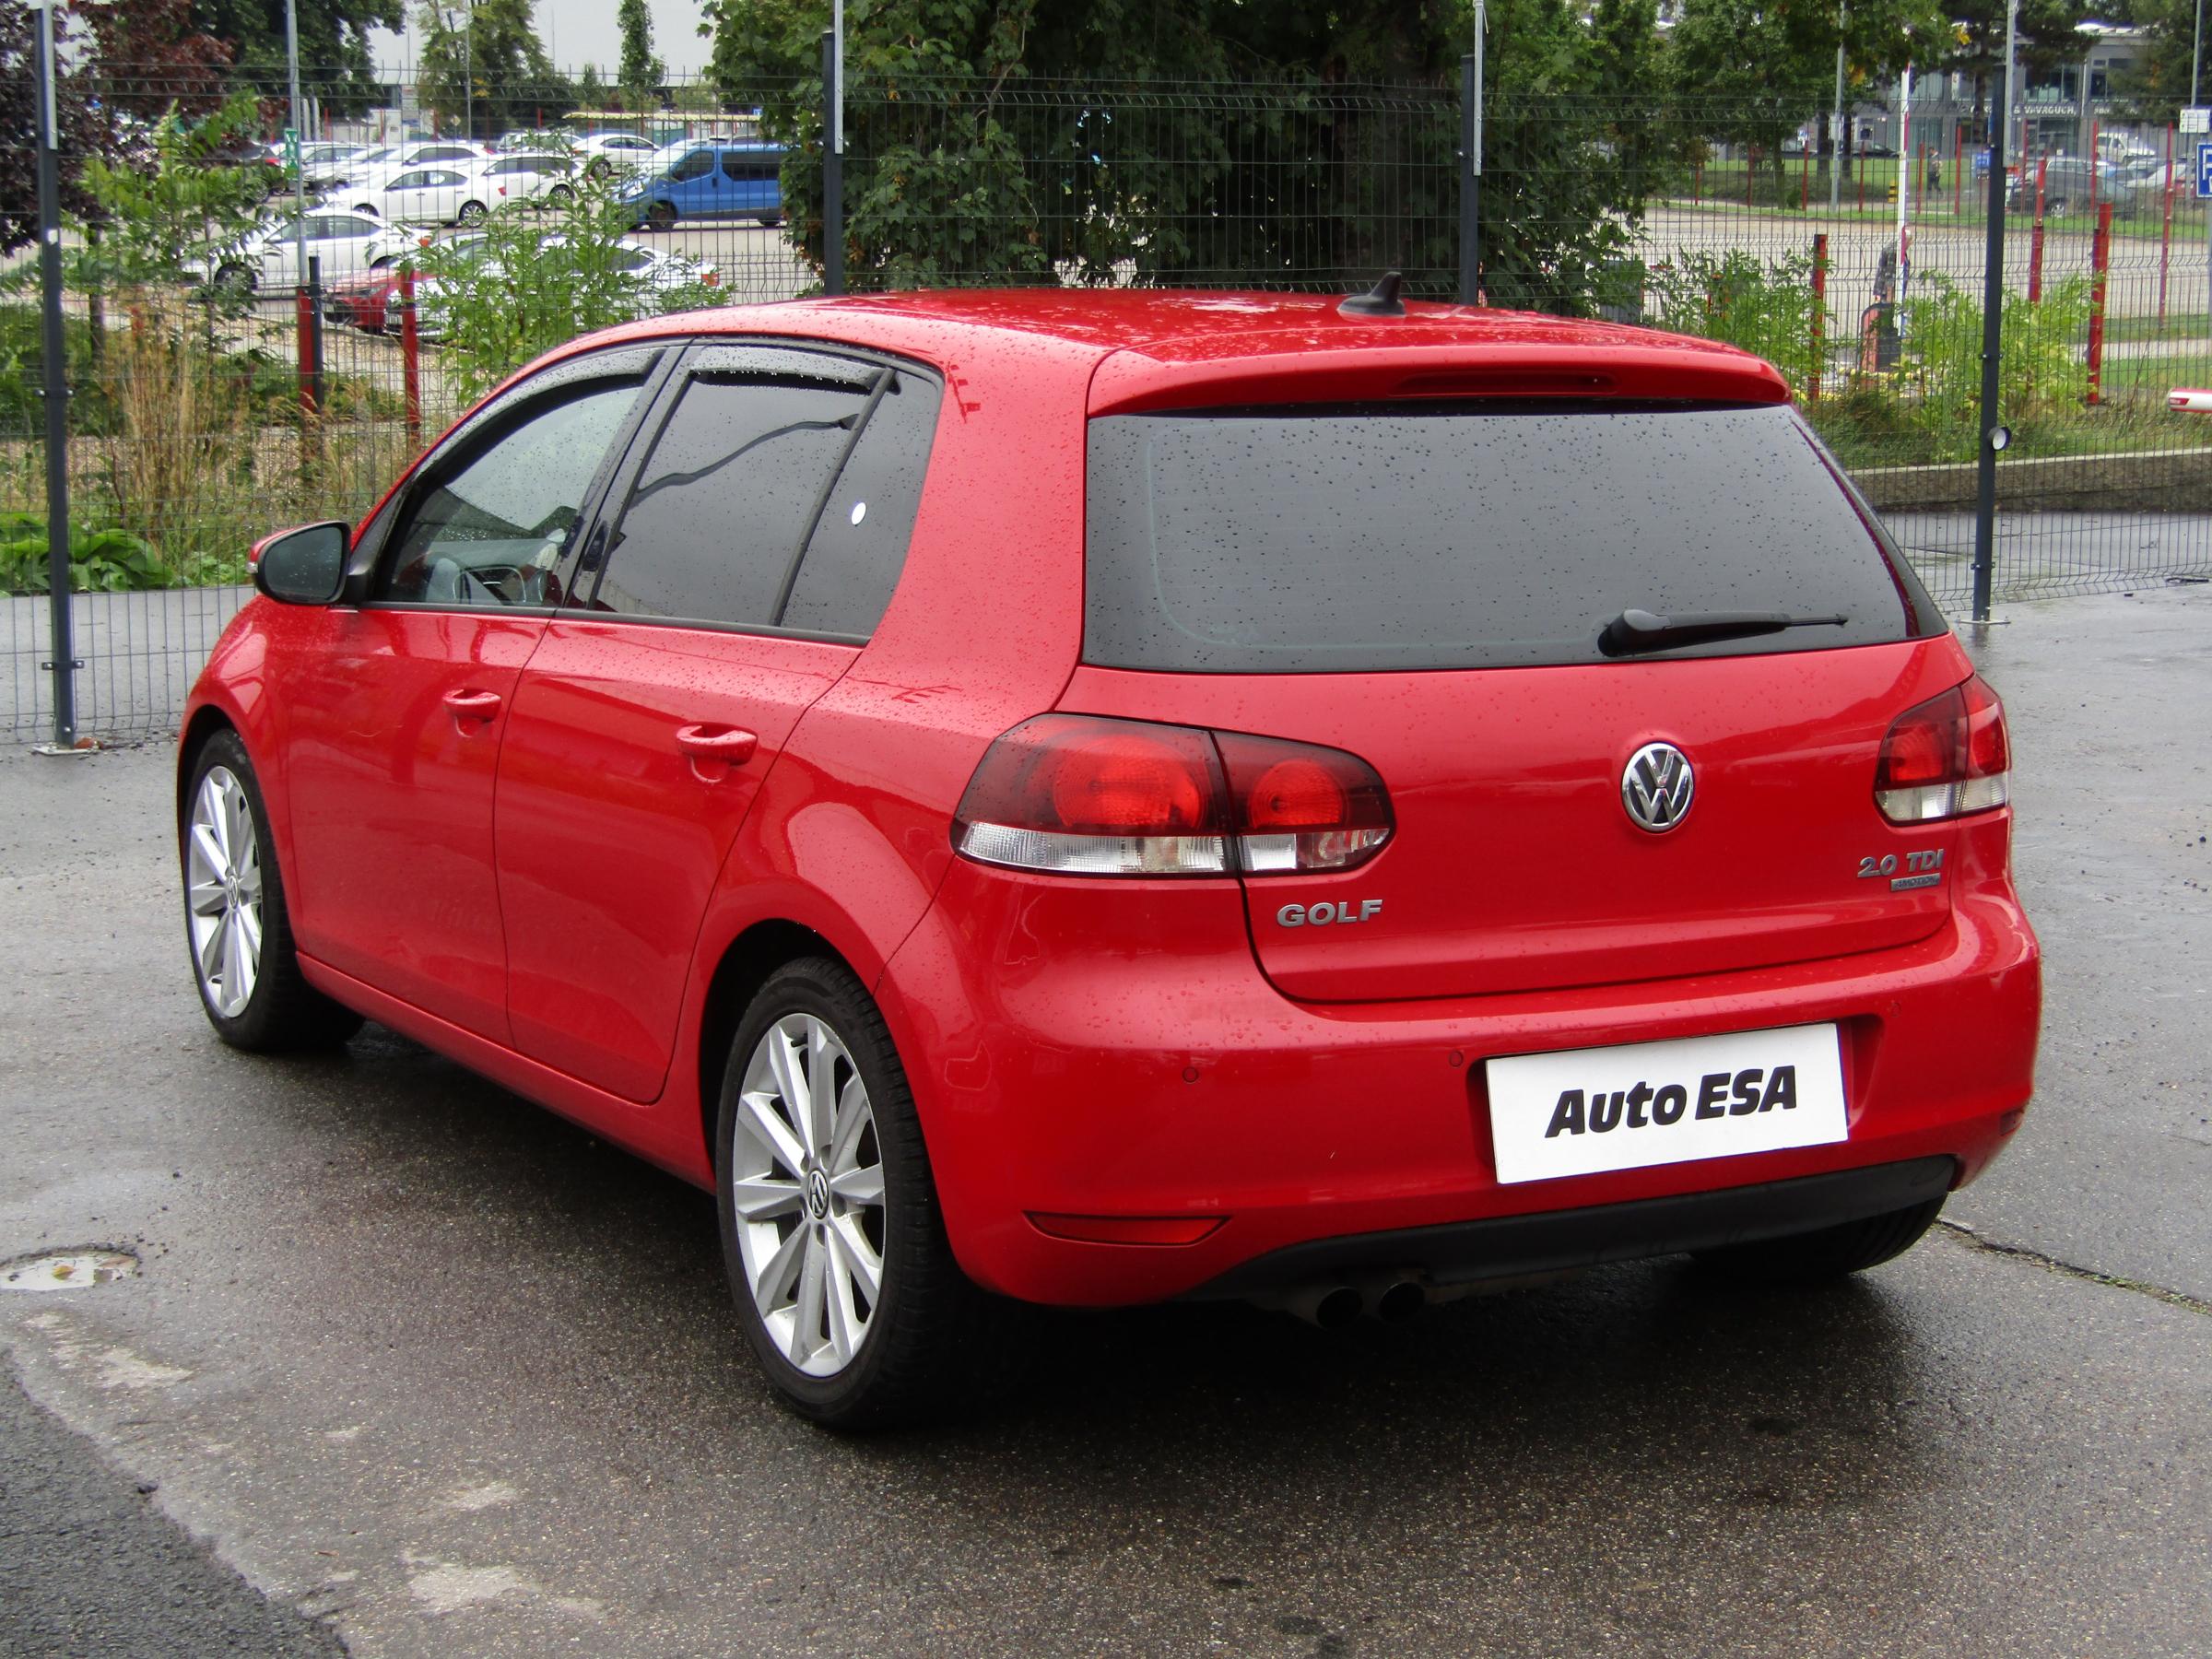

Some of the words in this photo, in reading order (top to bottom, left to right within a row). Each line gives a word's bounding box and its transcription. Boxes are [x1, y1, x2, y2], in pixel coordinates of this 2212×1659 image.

[1906, 848, 1945, 872] TDI
[1277, 899, 1382, 927] GOLF
[1544, 1080, 1687, 1138] Auto
[1694, 1065, 1796, 1120] ESA
